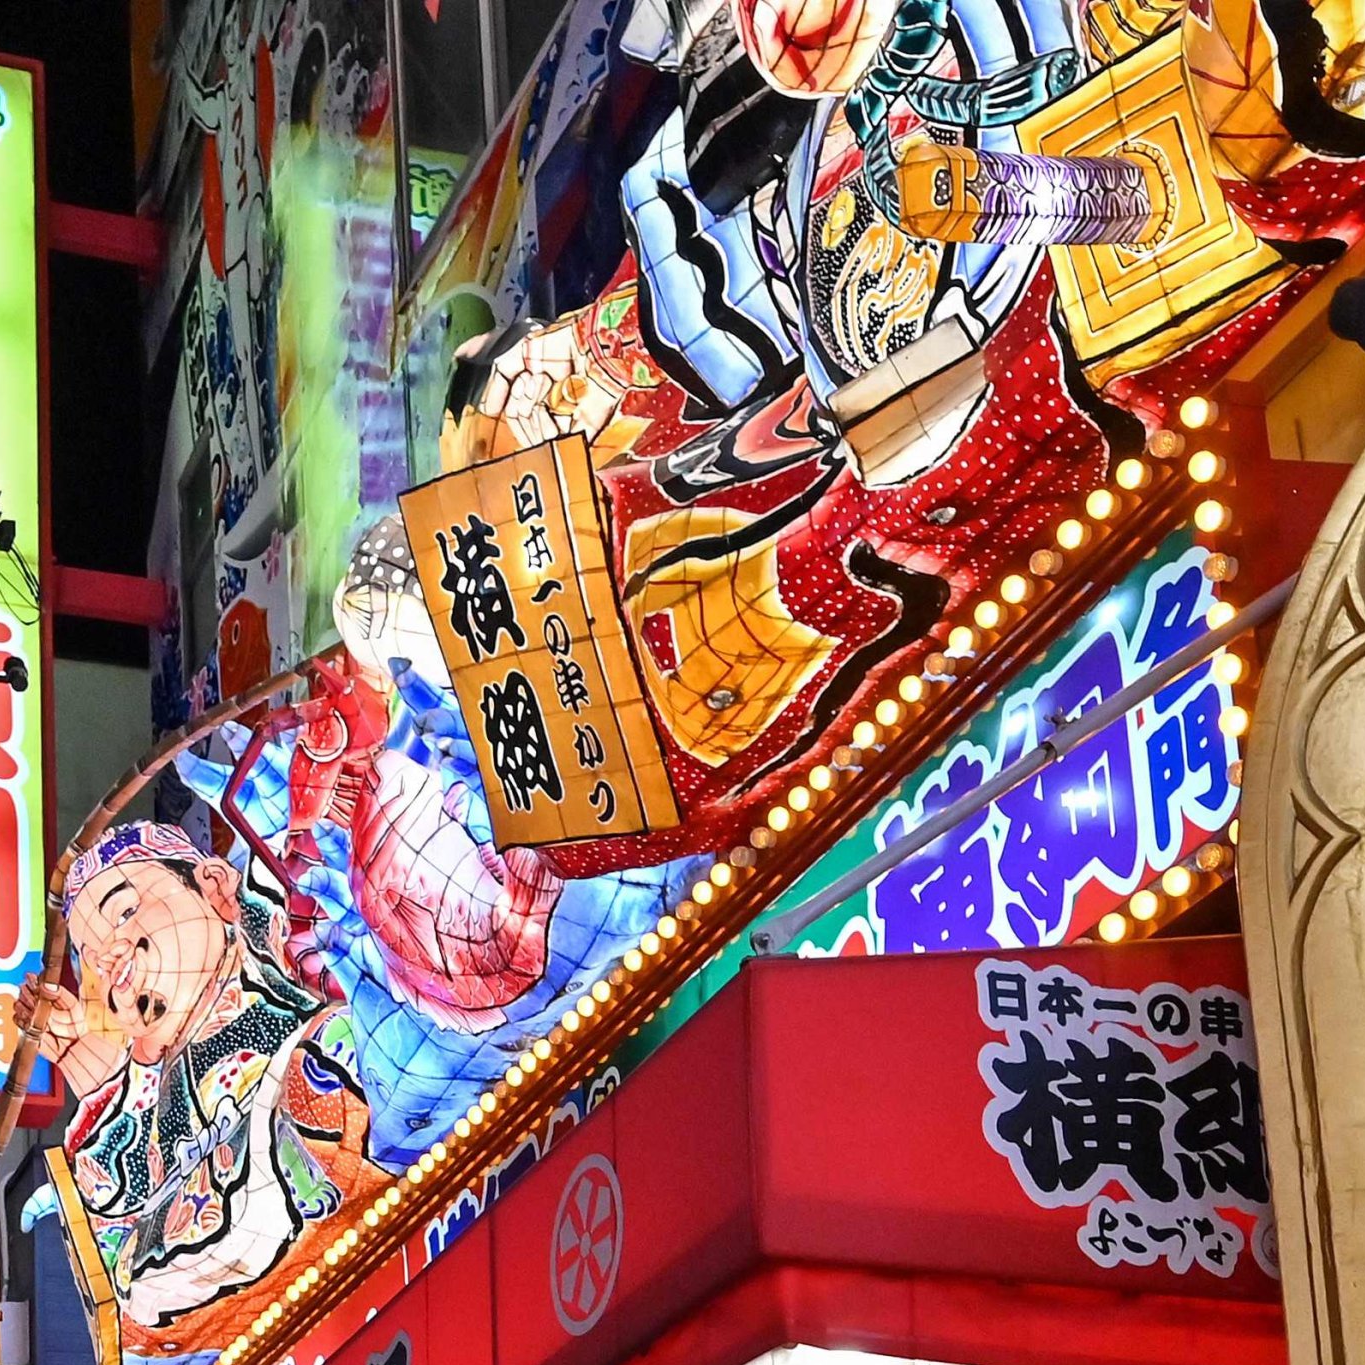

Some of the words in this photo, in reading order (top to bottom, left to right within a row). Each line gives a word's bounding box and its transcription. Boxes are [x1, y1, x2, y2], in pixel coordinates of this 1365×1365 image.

[436, 514, 565, 812] 横綱
[513, 474, 617, 824] 日本一の串かつ
[1088, 1207, 1235, 1266] よこづな
